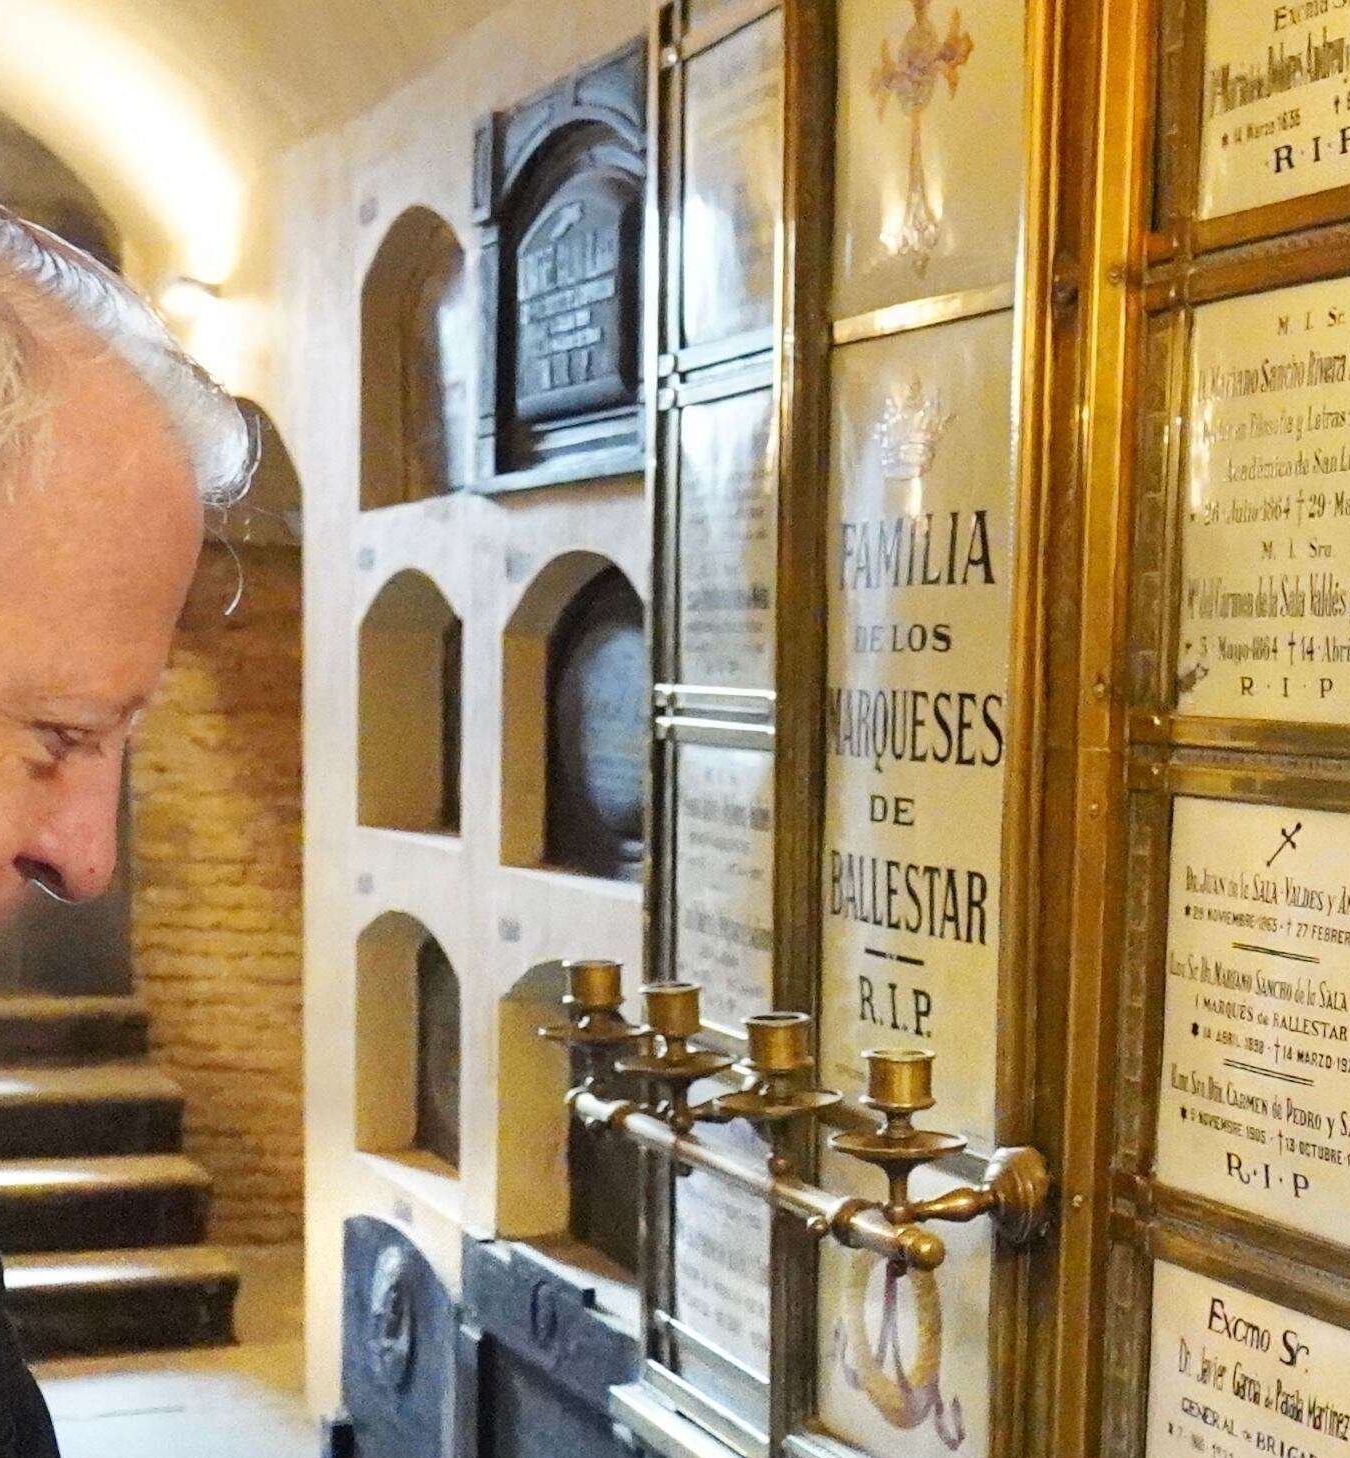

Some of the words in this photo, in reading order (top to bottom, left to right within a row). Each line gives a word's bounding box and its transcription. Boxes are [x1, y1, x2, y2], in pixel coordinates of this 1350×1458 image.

[1261, 354, 1304, 392] Sancho
[1307, 350, 1347, 388] Rivera
[1313, 448, 1337, 475] San
[840, 509, 996, 591] FAMILIA
[1280, 573, 1305, 618] Sala
[1310, 572, 1347, 617] Valdés
[854, 625, 884, 653] DE
[891, 623, 953, 653] LOS
[827, 687, 1004, 774] MARQUESES
[870, 794, 915, 827] DE
[830, 849, 987, 945] BALLESTAR
[1296, 922, 1308, 940] 27
[1255, 969, 1292, 1000] SANCHO
[1272, 1013, 1348, 1042] BALLESTAR
[1216, 1029, 1241, 1048] ABRIL
[1297, 1048, 1332, 1069] MARZO
[1226, 1081, 1269, 1116] CARMEN
[1286, 1097, 1321, 1131] PEDRO
[1198, 1110, 1243, 1137] NOVIEMBRE
[1299, 1140, 1343, 1166] OCTUBRE
[1207, 1297, 1271, 1353] Excmo
[1181, 1396, 1238, 1438] GENERAL
